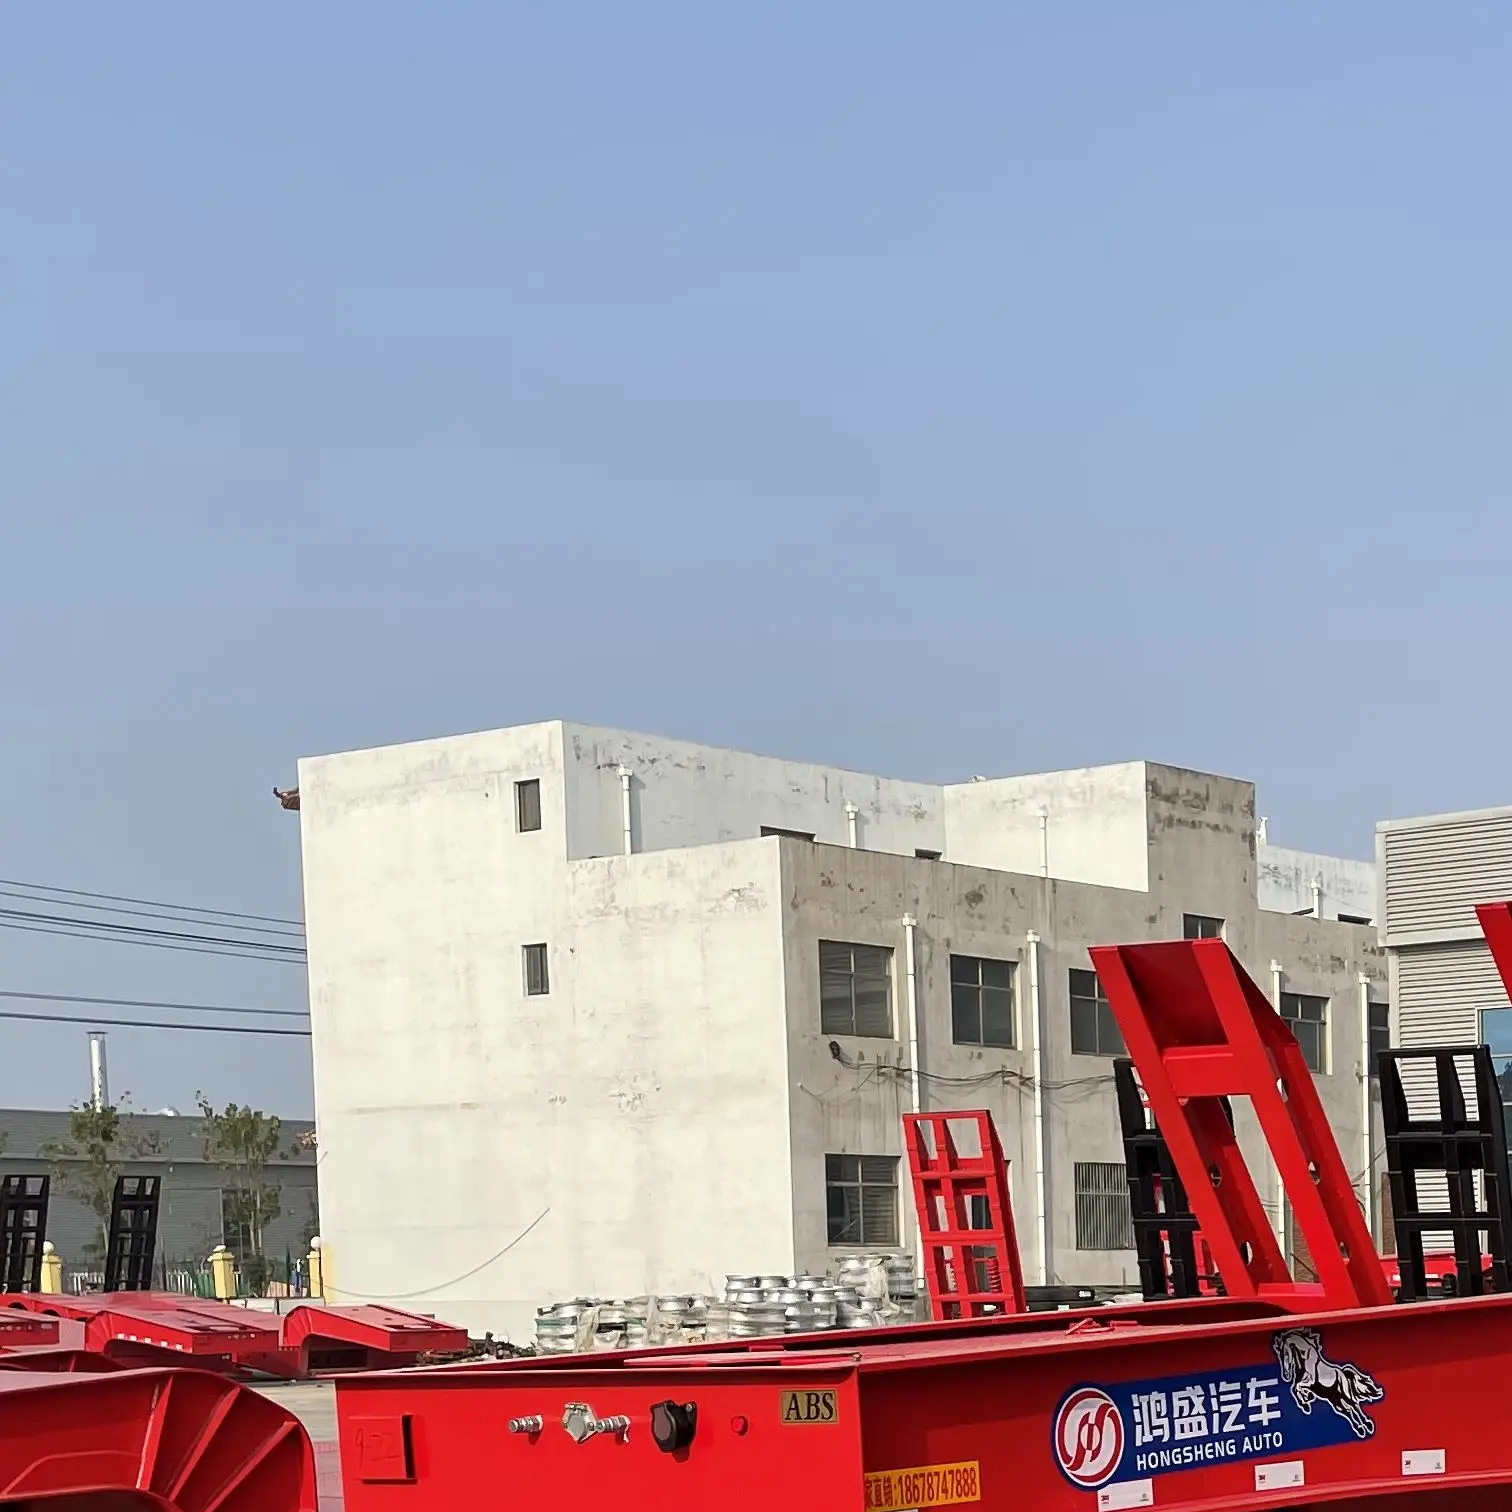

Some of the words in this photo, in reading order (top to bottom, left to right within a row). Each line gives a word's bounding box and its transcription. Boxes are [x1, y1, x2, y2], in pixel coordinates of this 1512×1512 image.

[784, 1392, 834, 1421] ABS
[1131, 1377, 1282, 1447] 鸿盛汽车
[1136, 1438, 1236, 1471] HONGSHENG
[1242, 1431, 1283, 1452] AUTO
